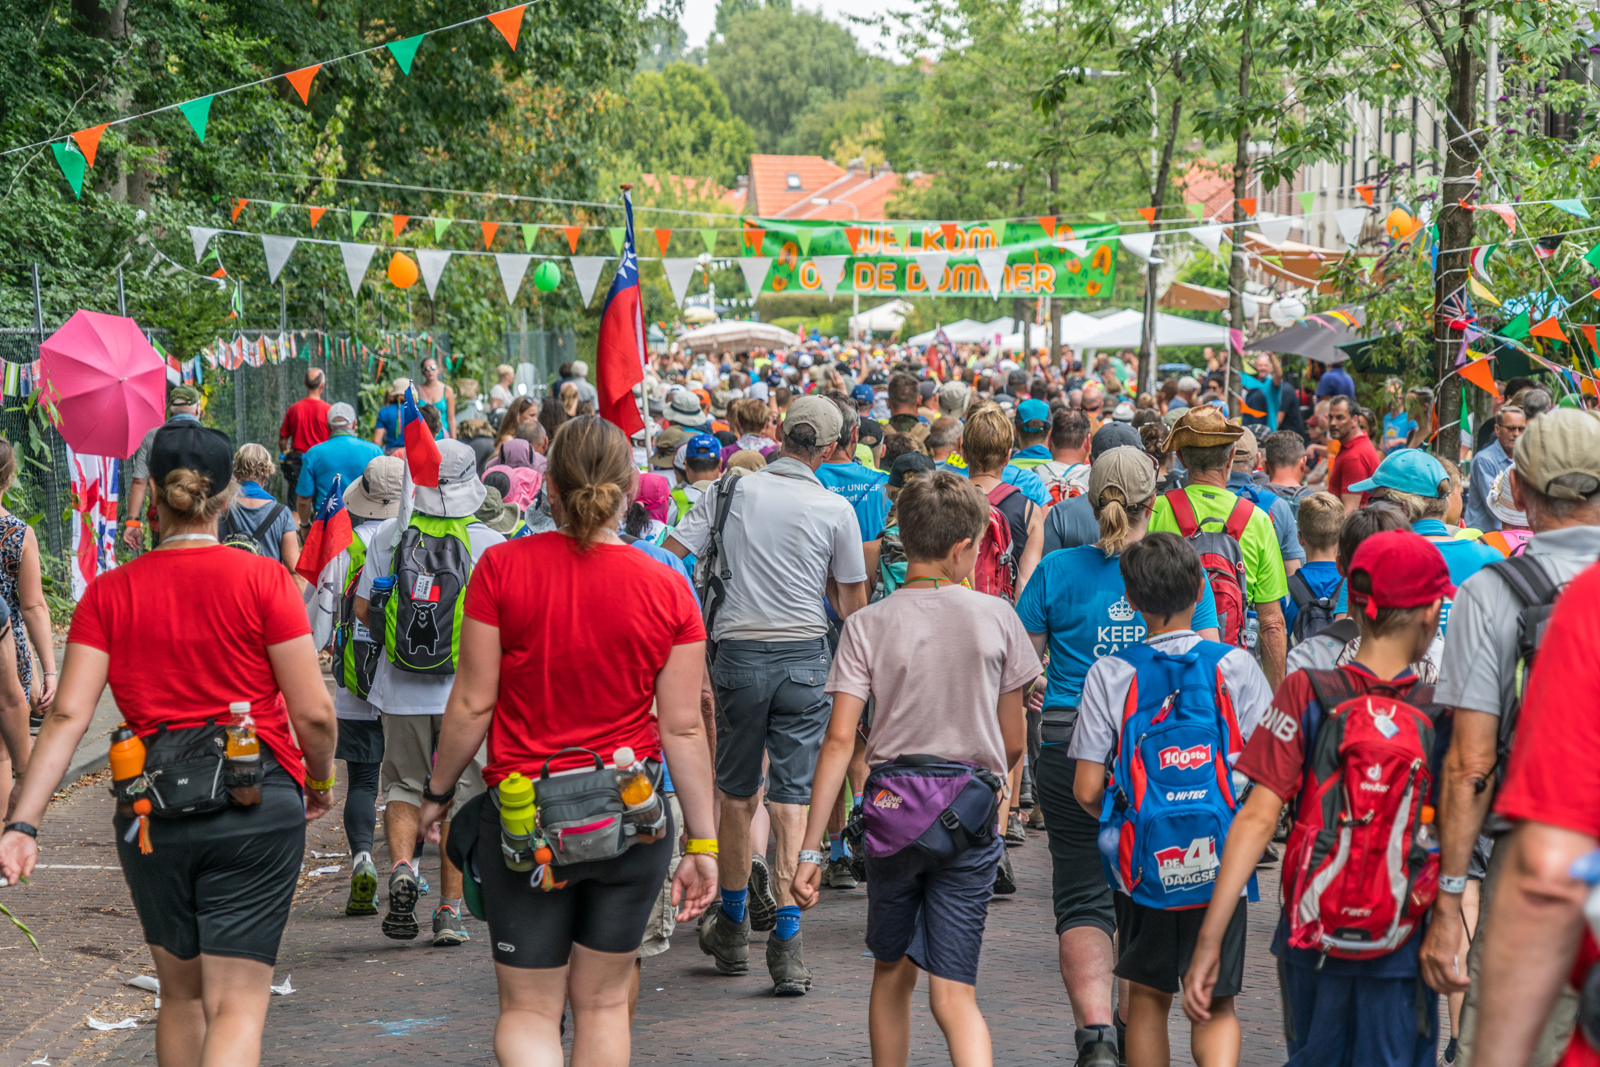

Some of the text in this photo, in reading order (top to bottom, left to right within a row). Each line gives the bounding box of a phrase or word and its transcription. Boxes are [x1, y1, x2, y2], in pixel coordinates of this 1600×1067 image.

[856, 225, 998, 256] WELKOM
[799, 260, 846, 291] O
[853, 261, 898, 292] DE
[1097, 625, 1146, 642] KEEP
[1163, 750, 1207, 765] 100ste
[1163, 836, 1215, 871] DE 4
[1163, 869, 1217, 887] DAAGSE
